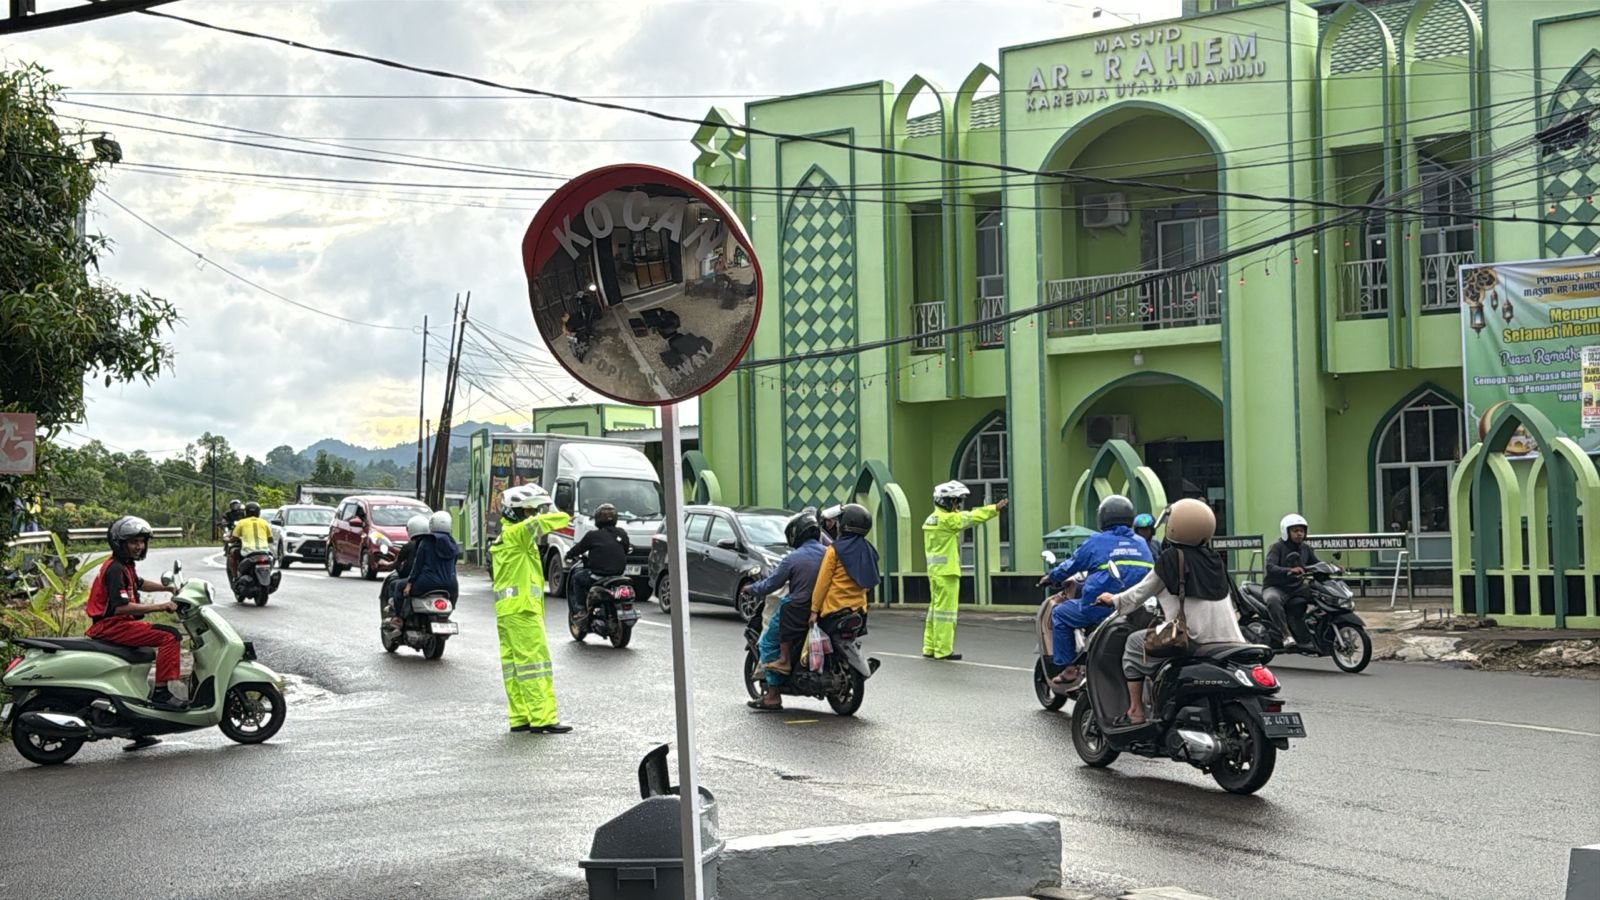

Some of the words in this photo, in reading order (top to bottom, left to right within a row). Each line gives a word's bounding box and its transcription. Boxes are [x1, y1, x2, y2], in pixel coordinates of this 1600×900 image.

[1026, 88, 1109, 112] KAREMA
[1116, 78, 1177, 98] UTARA
[1186, 61, 1266, 86] MAMUJU
[1503, 325, 1560, 342] Selamat
[1561, 322, 1600, 338] Menu
[1500, 351, 1531, 366] Puasa
[1533, 347, 1582, 365] Ramadha
[1474, 376, 1506, 385] Semoga
[1535, 372, 1559, 381] Puasa
[1323, 539, 1348, 548] PARKIR
[1349, 539, 1356, 548] DI
[1357, 539, 1379, 548] DEPAN
[1380, 538, 1402, 547] PINTU
